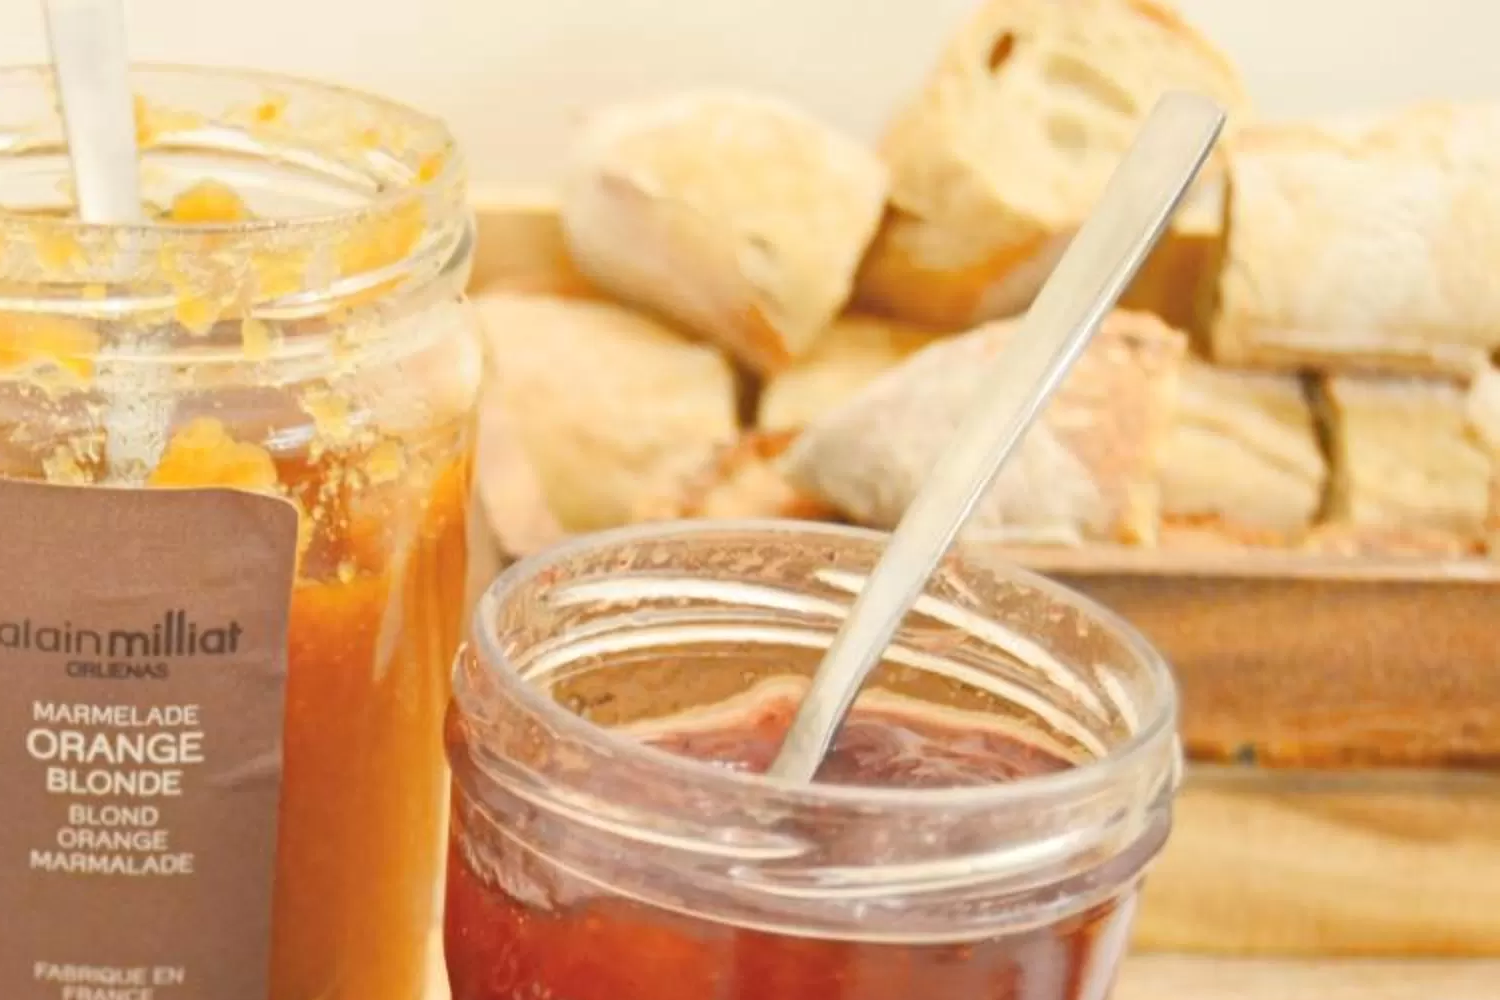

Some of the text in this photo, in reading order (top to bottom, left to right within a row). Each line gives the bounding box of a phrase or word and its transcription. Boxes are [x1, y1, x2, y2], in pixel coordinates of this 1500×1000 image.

[32, 700, 201, 727] MARMELADE
[26, 727, 206, 765] ORANGE
[46, 766, 185, 796] BLONDE
[68, 803, 160, 827] BLOND
[56, 827, 170, 852] ORANGE
[29, 848, 196, 876] MARMALADE
[32, 960, 187, 986] FABRIQUE EN
